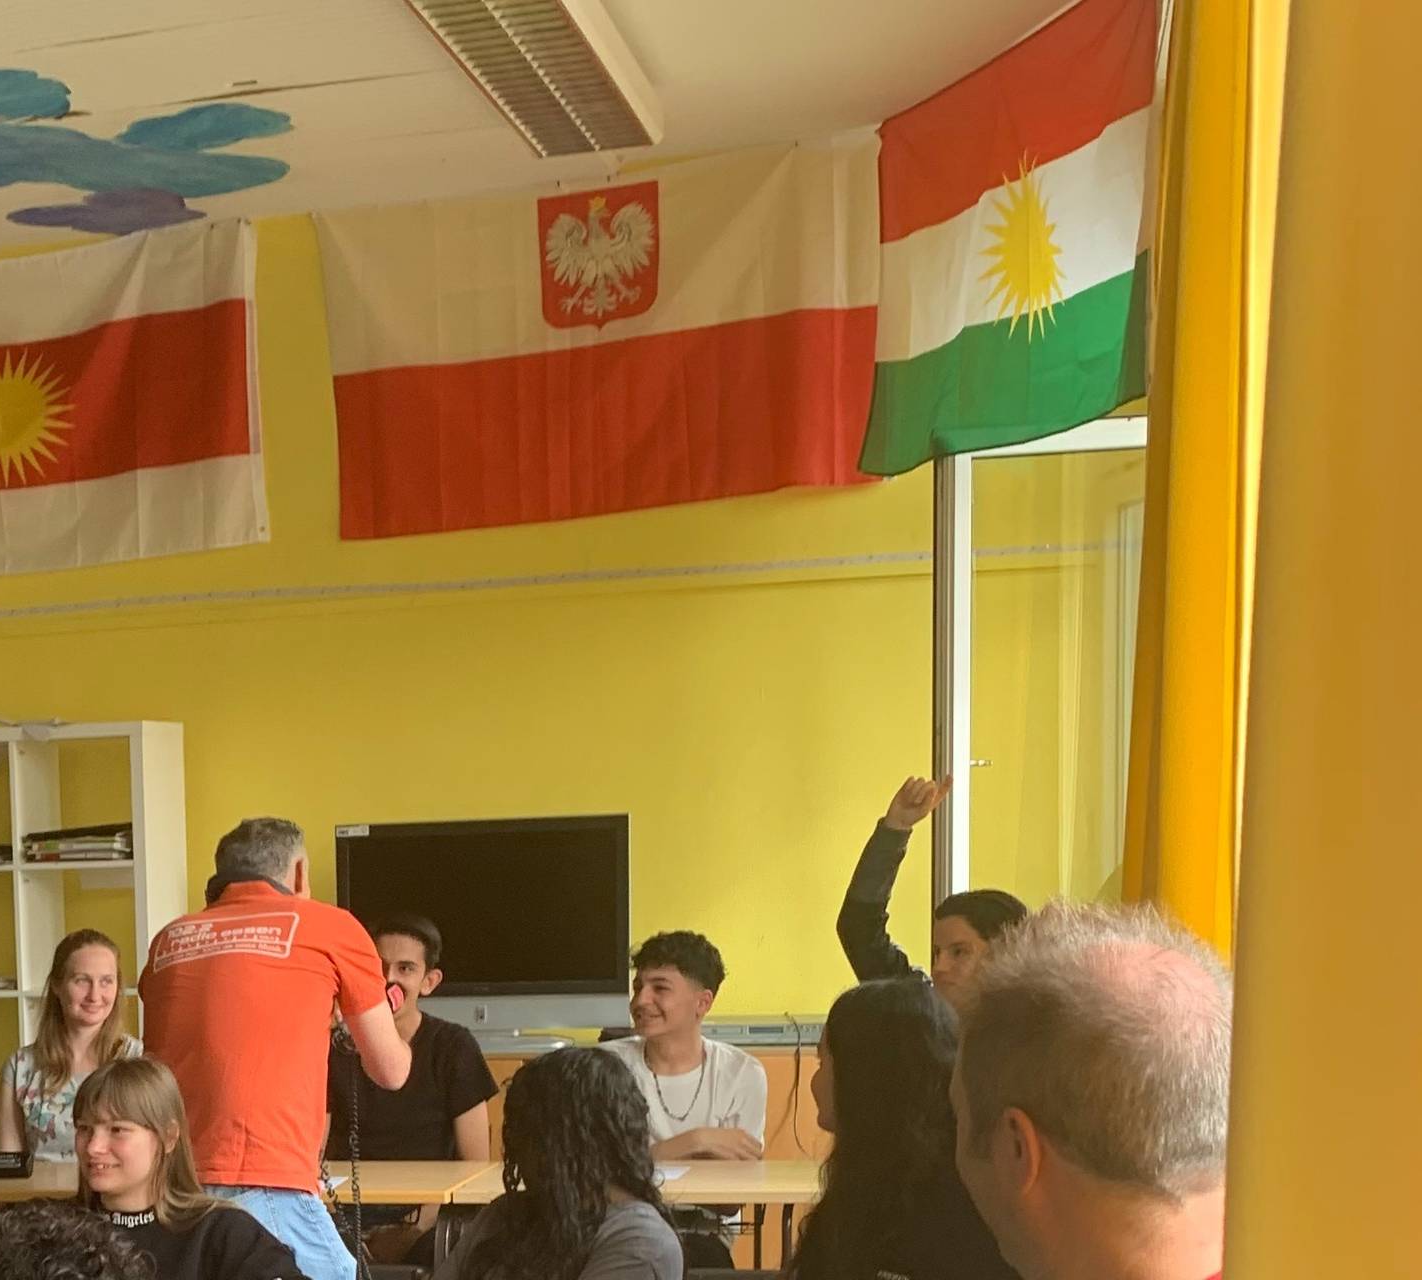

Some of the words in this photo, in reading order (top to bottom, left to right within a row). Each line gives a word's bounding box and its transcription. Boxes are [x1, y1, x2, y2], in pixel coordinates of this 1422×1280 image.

[169, 923, 213, 938] 102.2
[171, 931, 217, 947] radio
[221, 926, 282, 938] essen
[112, 1211, 155, 1228] Angeles
